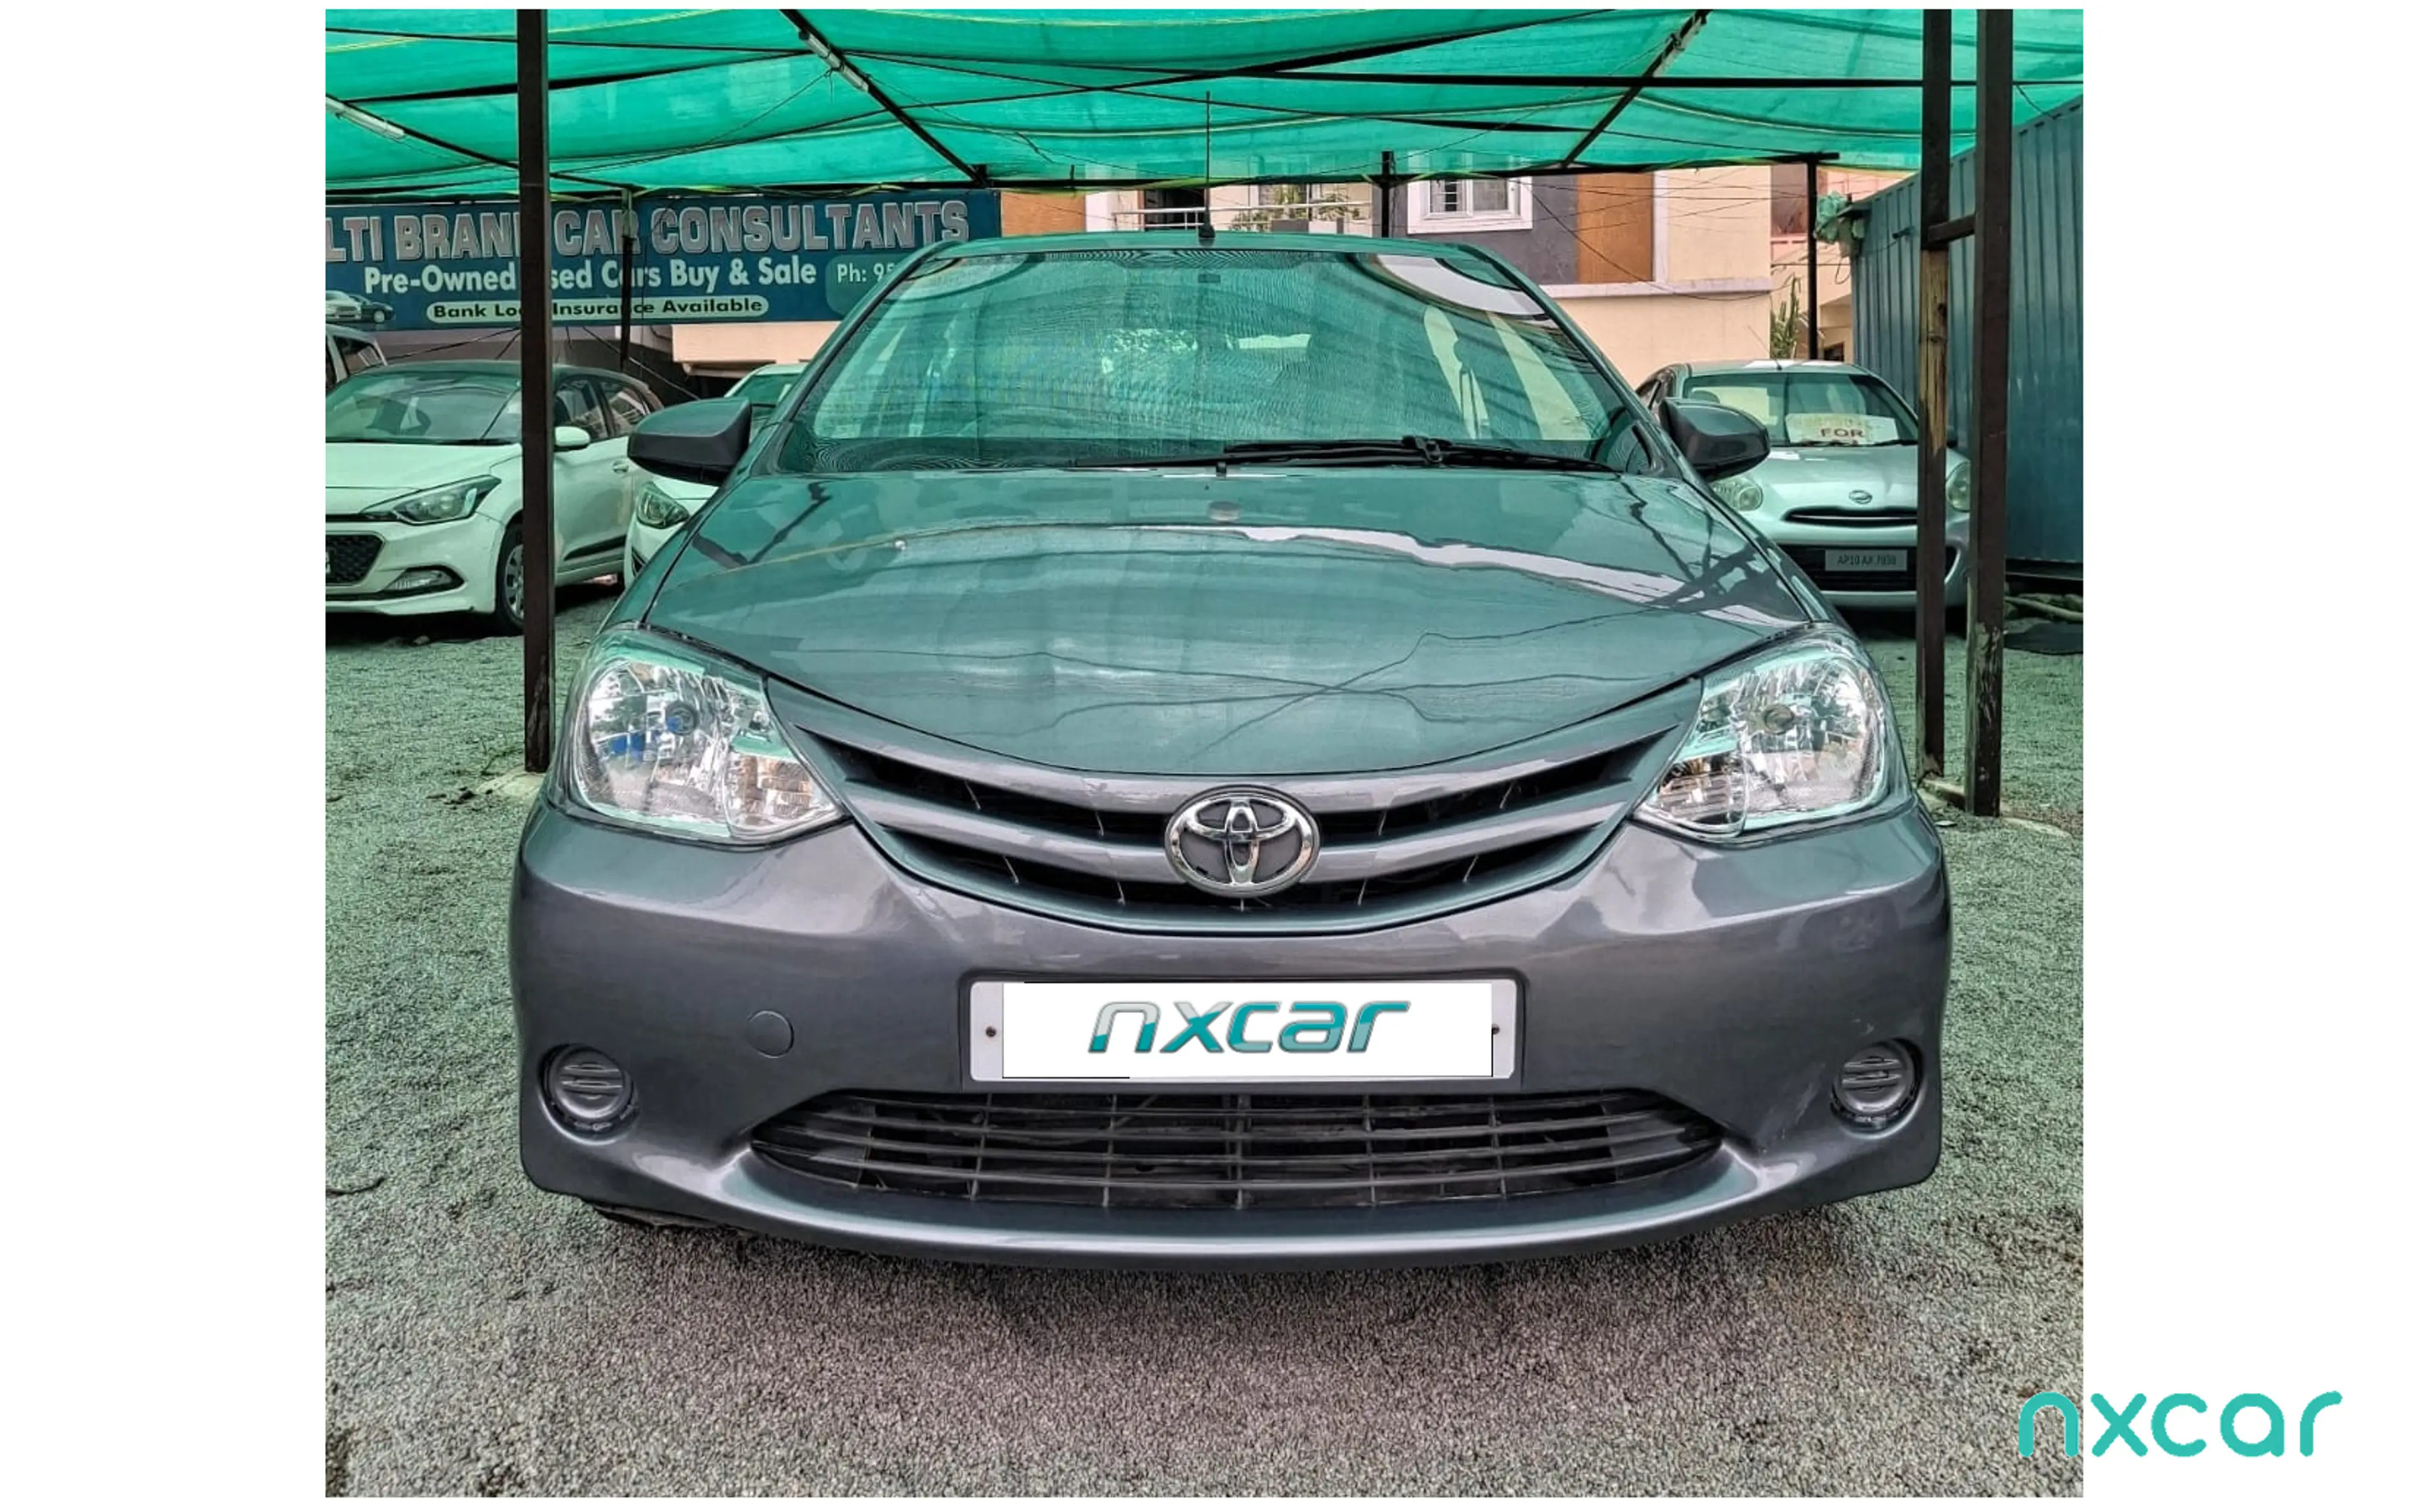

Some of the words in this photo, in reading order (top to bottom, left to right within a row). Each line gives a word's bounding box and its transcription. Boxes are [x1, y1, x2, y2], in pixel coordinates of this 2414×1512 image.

[394, 211, 521, 260] BRAN
[554, 209, 641, 256] CAR
[651, 201, 969, 253] CONSULTANTS
[364, 260, 517, 294] Pre-Owned
[551, 259, 593, 289] sed
[670, 258, 724, 294] Buy
[728, 257, 751, 286] &
[758, 255, 817, 285] Sale
[837, 262, 867, 283] Ph:
[434, 303, 487, 318] Bank
[495, 303, 521, 317] Lo
[553, 302, 655, 316] Insurace
[663, 298, 763, 313] Available
[1820, 428, 1865, 438] FOR
